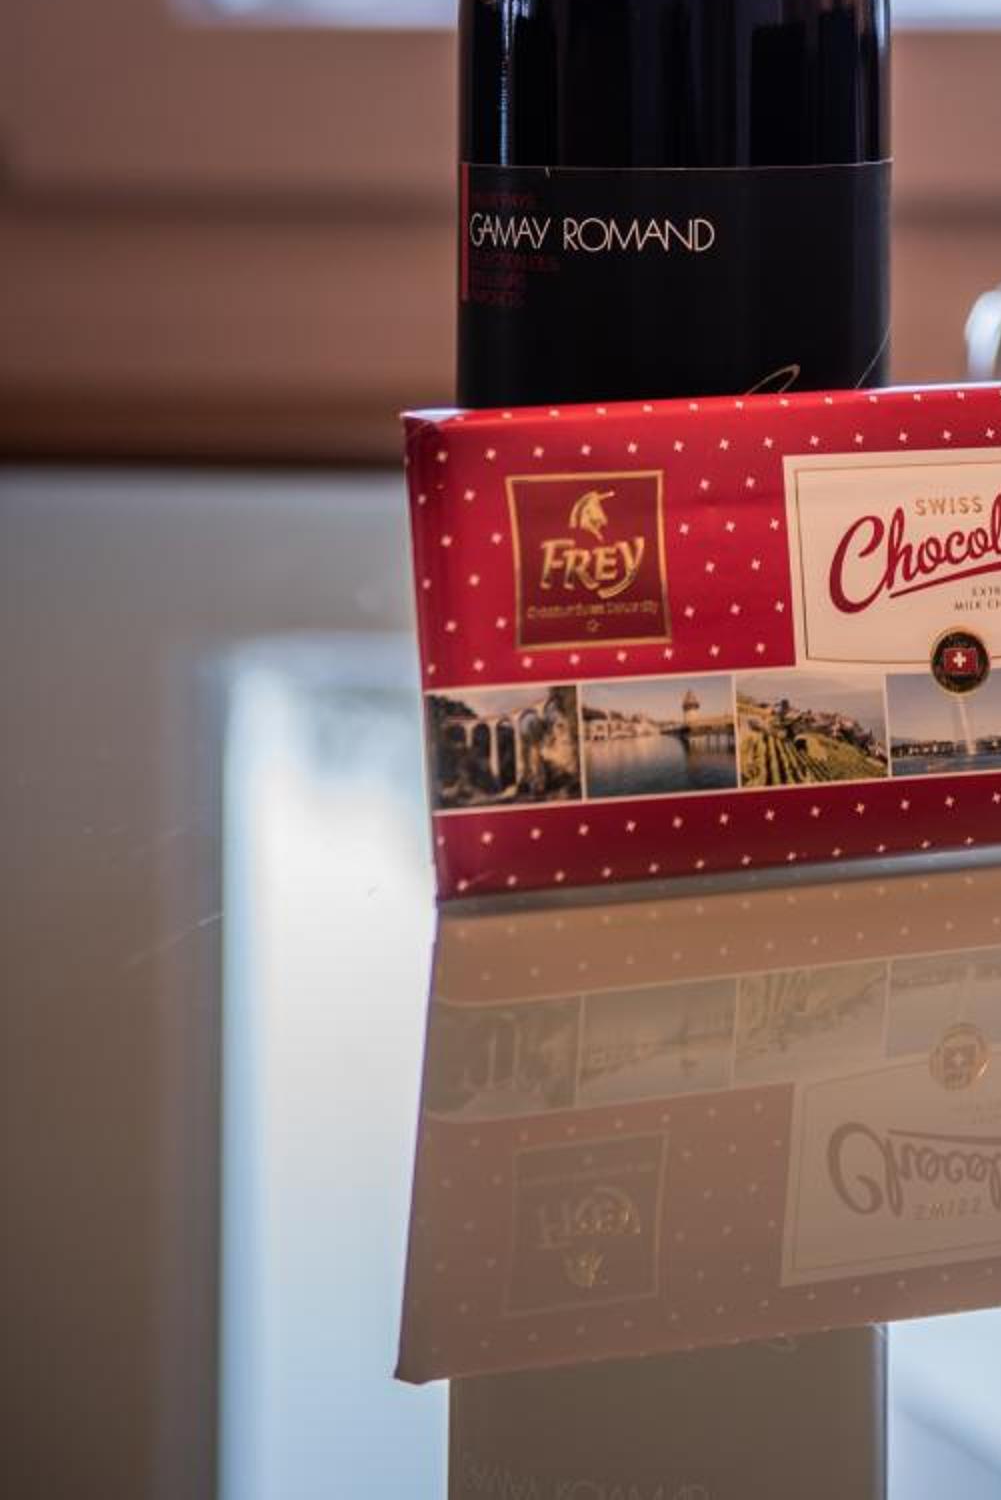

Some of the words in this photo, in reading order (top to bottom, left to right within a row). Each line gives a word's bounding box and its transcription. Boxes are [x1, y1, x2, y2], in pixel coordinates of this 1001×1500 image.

[469, 212, 551, 249] GAMAY
[563, 217, 716, 252] ROMAND
[914, 495, 984, 517] SWISS
[540, 536, 645, 599] FREY
[954, 600, 981, 612] MILK
